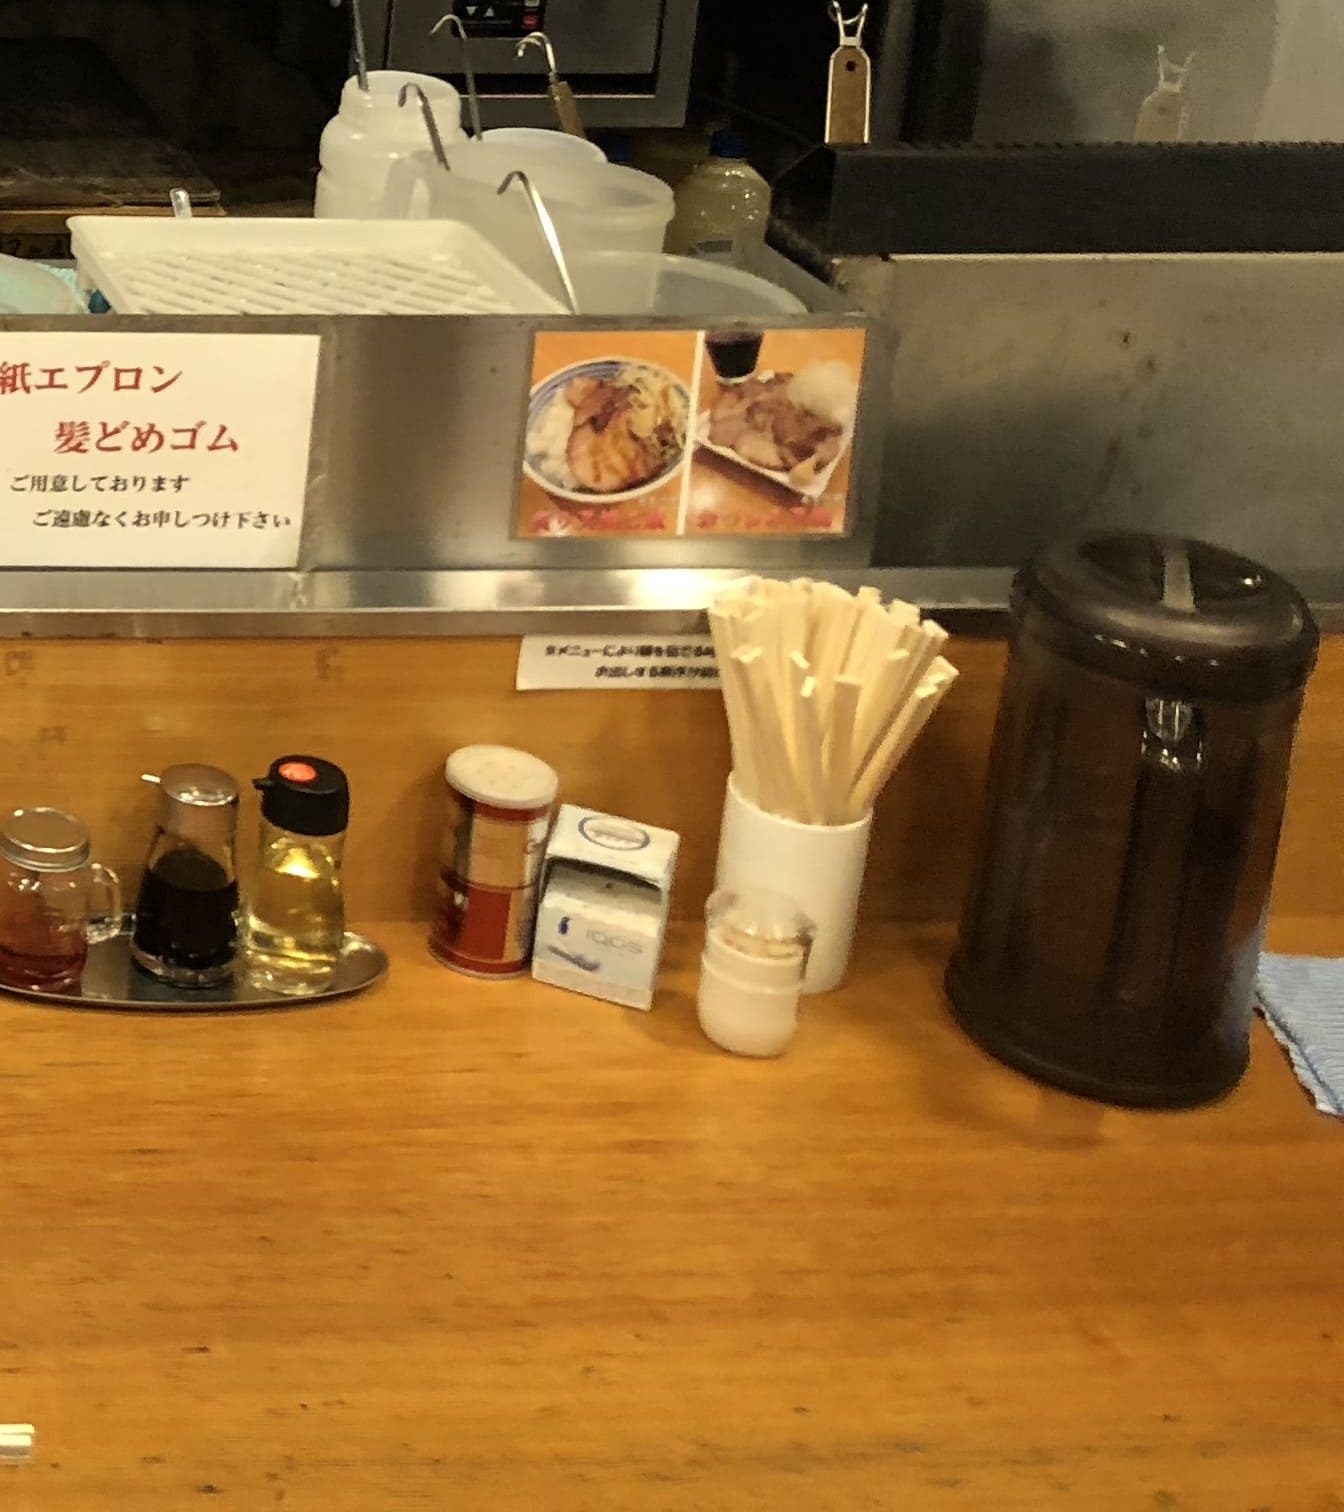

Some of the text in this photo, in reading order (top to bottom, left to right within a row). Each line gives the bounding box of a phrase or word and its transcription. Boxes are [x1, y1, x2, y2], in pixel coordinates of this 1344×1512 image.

[53, 420, 240, 454] 髪どめゴム
[9, 474, 191, 493] ご用意しております
[32, 509, 292, 529] ご遠慮なくお申しつけ下さい
